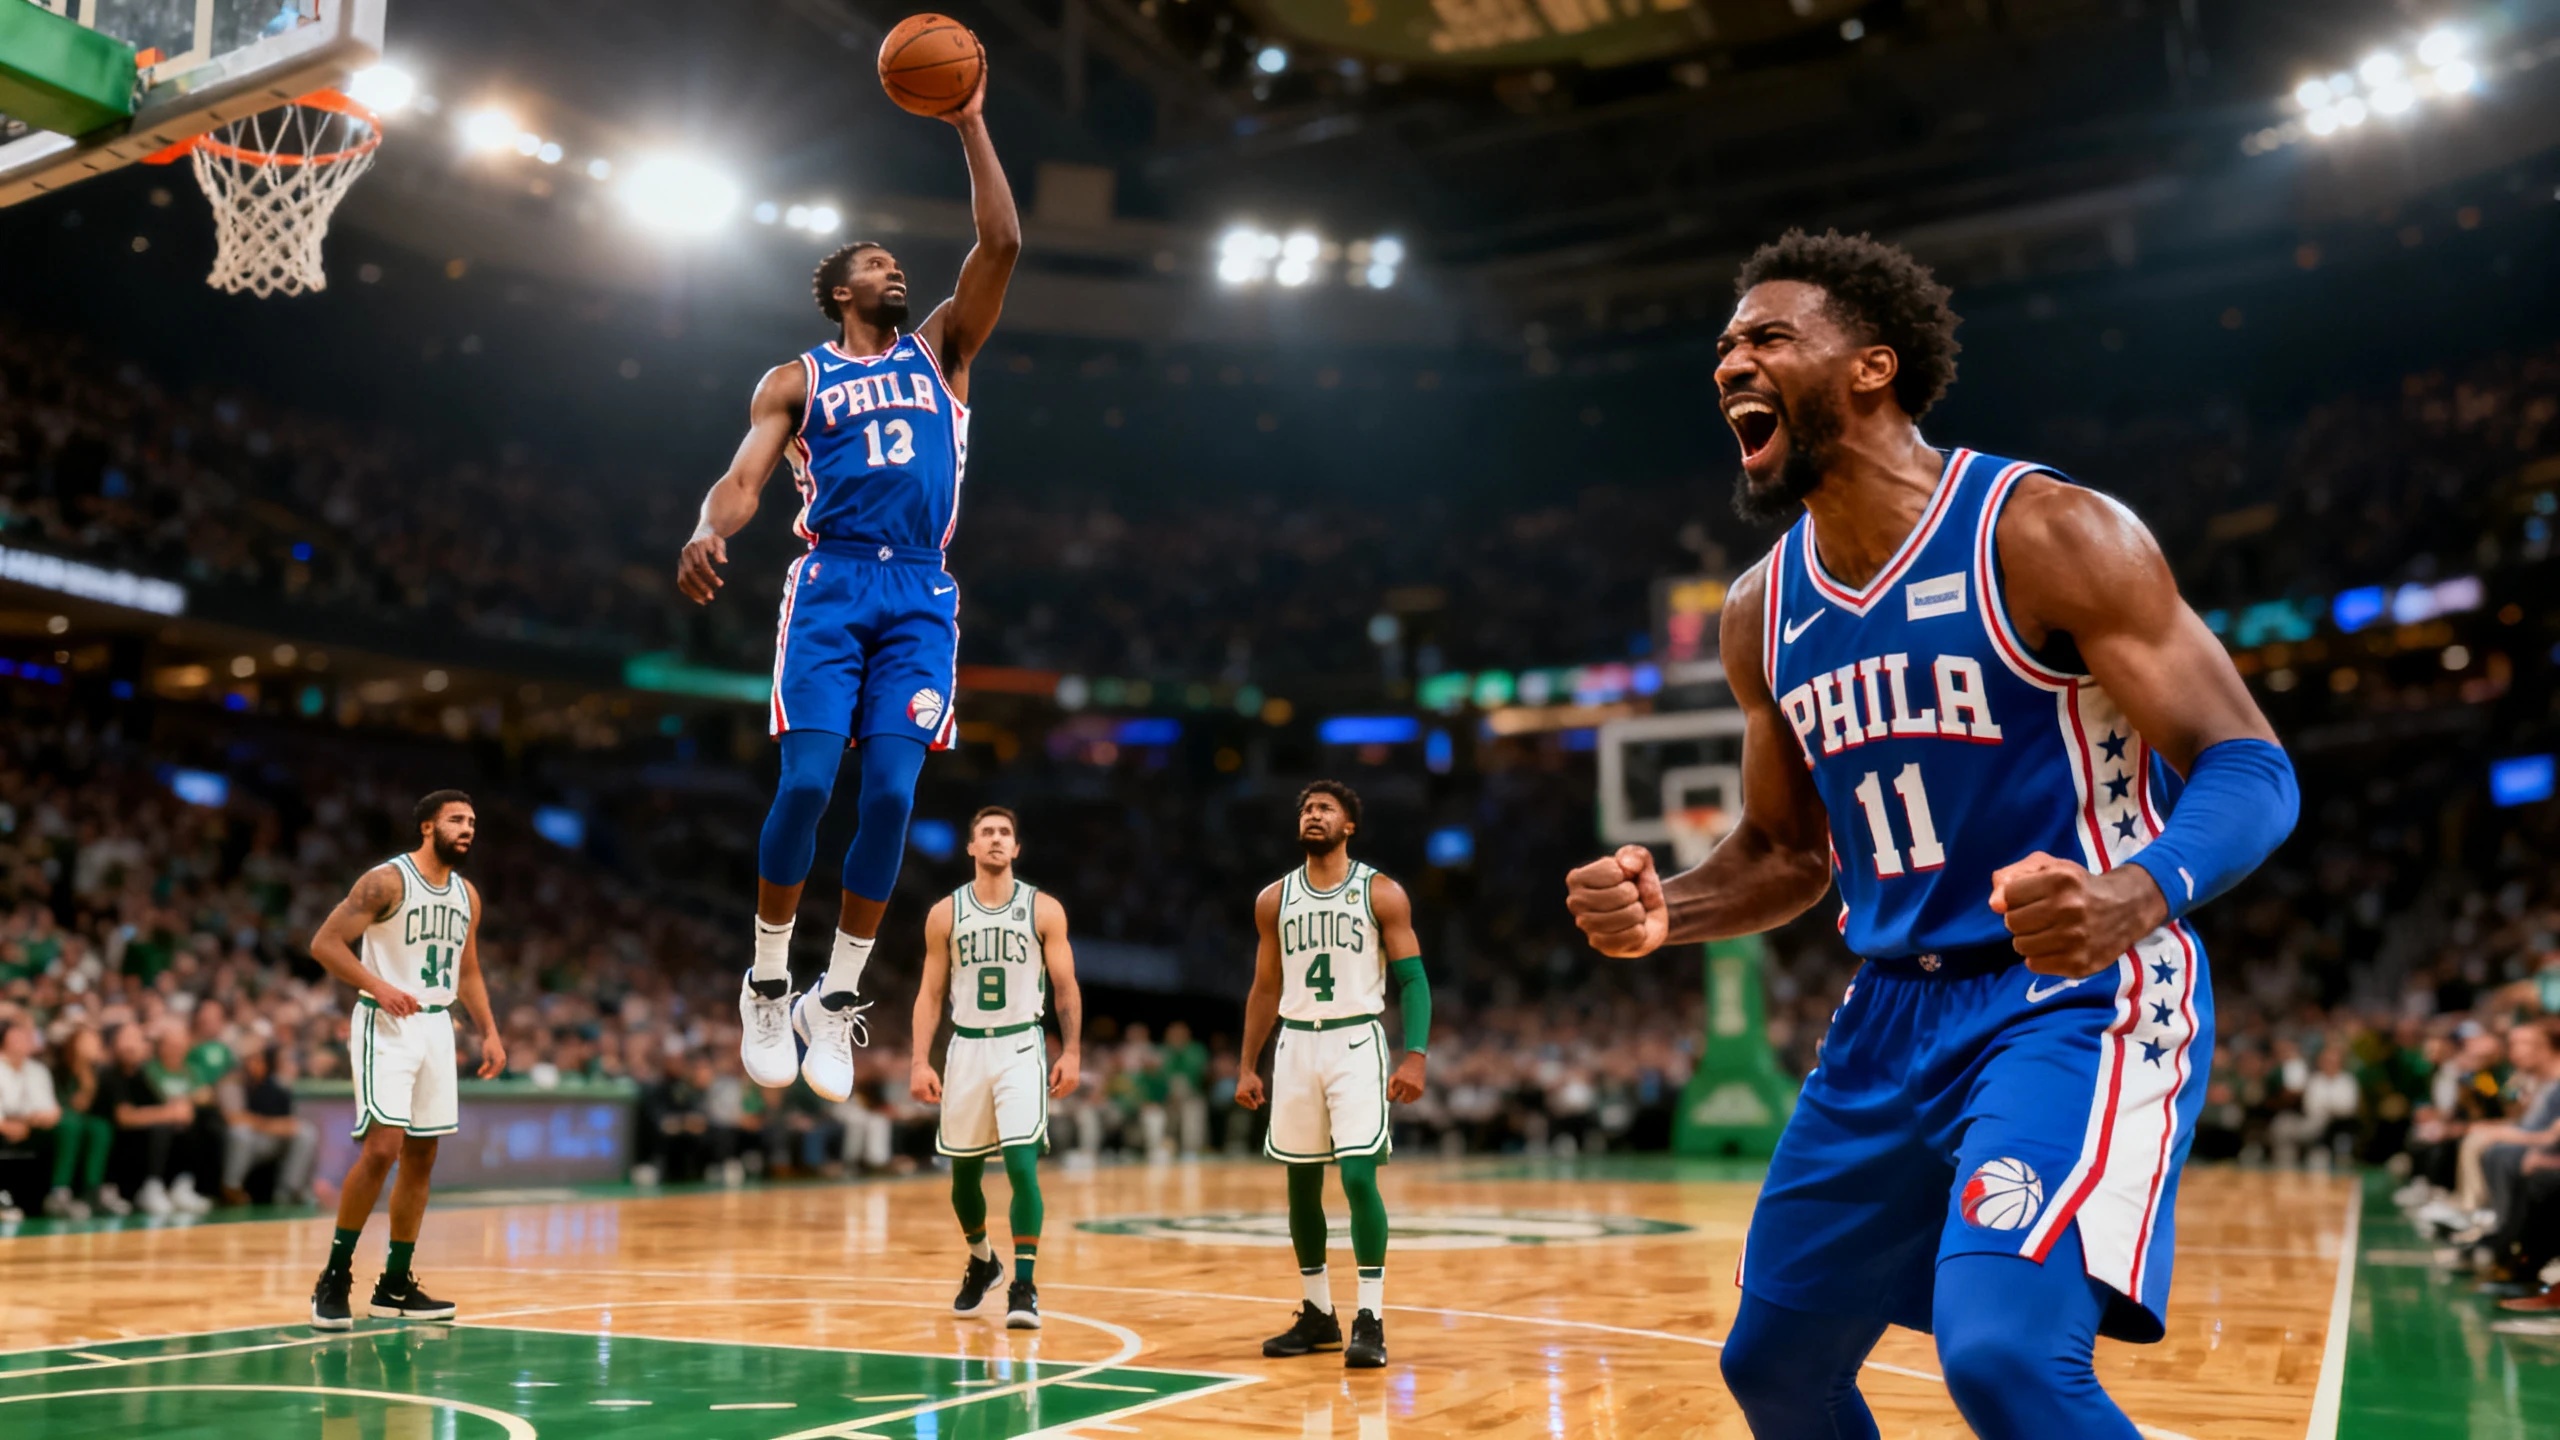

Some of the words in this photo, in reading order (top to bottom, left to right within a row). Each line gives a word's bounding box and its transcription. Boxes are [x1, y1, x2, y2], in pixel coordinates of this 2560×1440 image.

[816, 371, 939, 430] PHILA
[1779, 652, 2004, 771] PHILA
[1854, 762, 1946, 881] 11
[976, 966, 1007, 1011] 8
[1305, 953, 1335, 1002] 4
